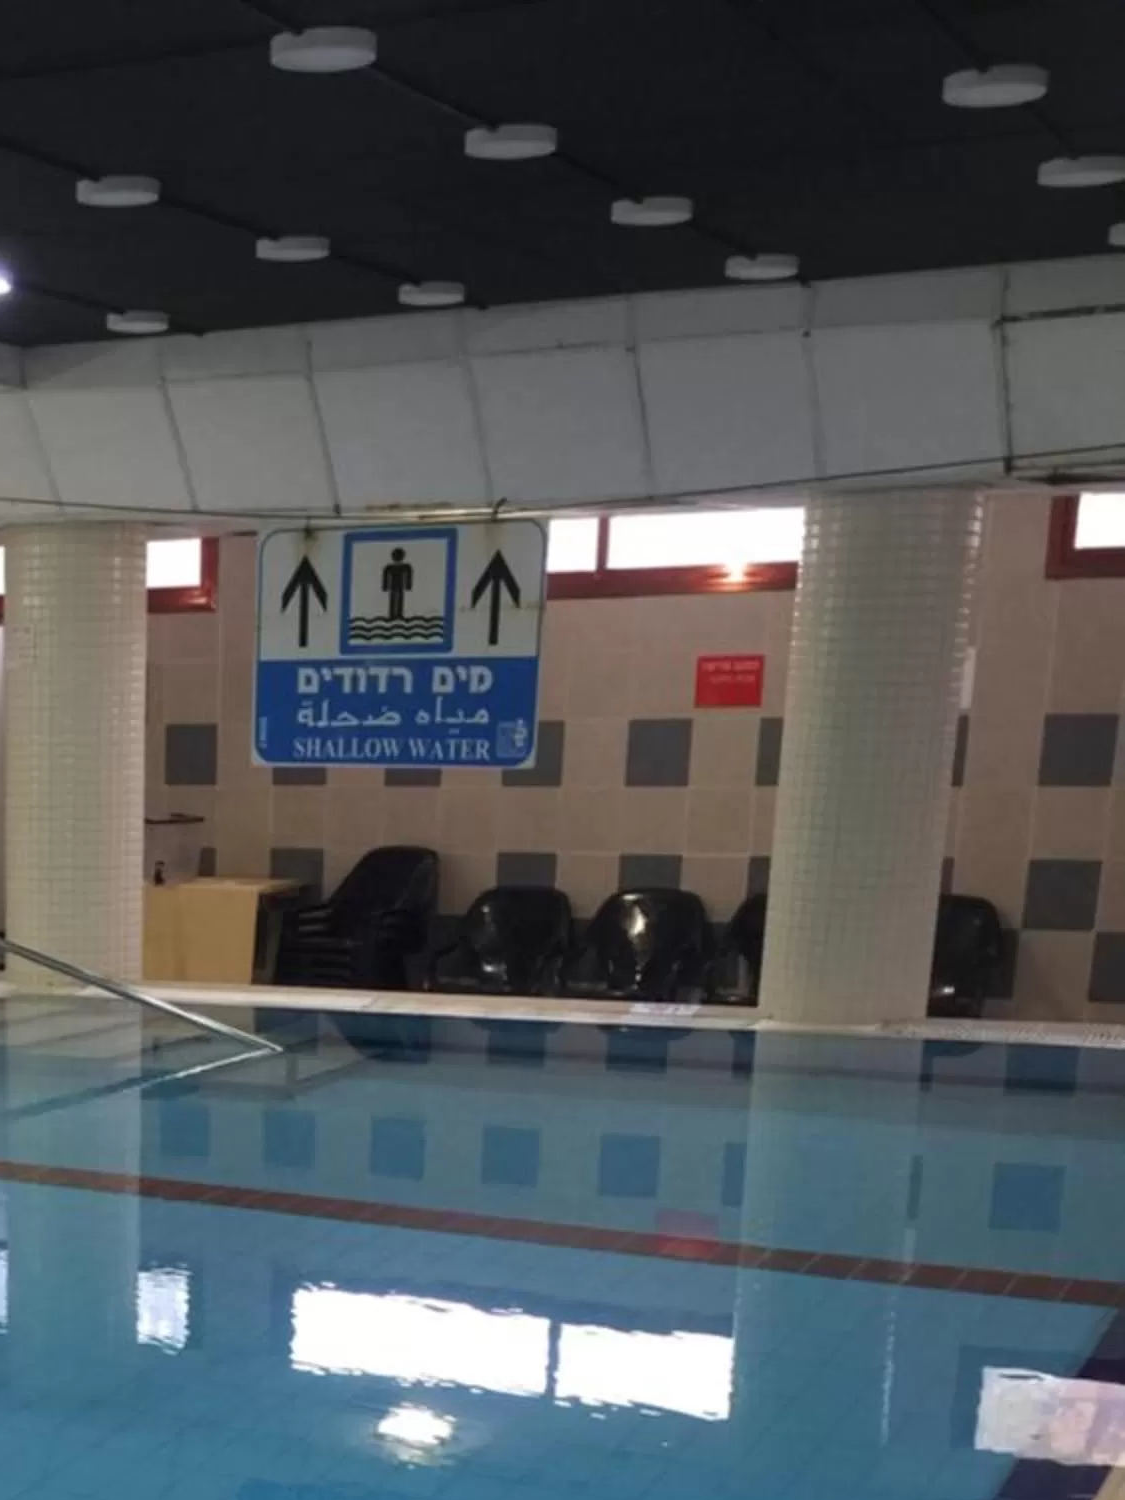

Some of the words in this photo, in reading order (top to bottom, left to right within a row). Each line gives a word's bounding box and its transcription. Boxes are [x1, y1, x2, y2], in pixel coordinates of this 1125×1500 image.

[296, 666, 413, 694] רדודים
[432, 665, 493, 694] מים
[297, 699, 402, 728] ضحلة
[415, 697, 489, 735] مياه
[292, 738, 401, 761] SHALLOW
[408, 738, 490, 761] WATER
